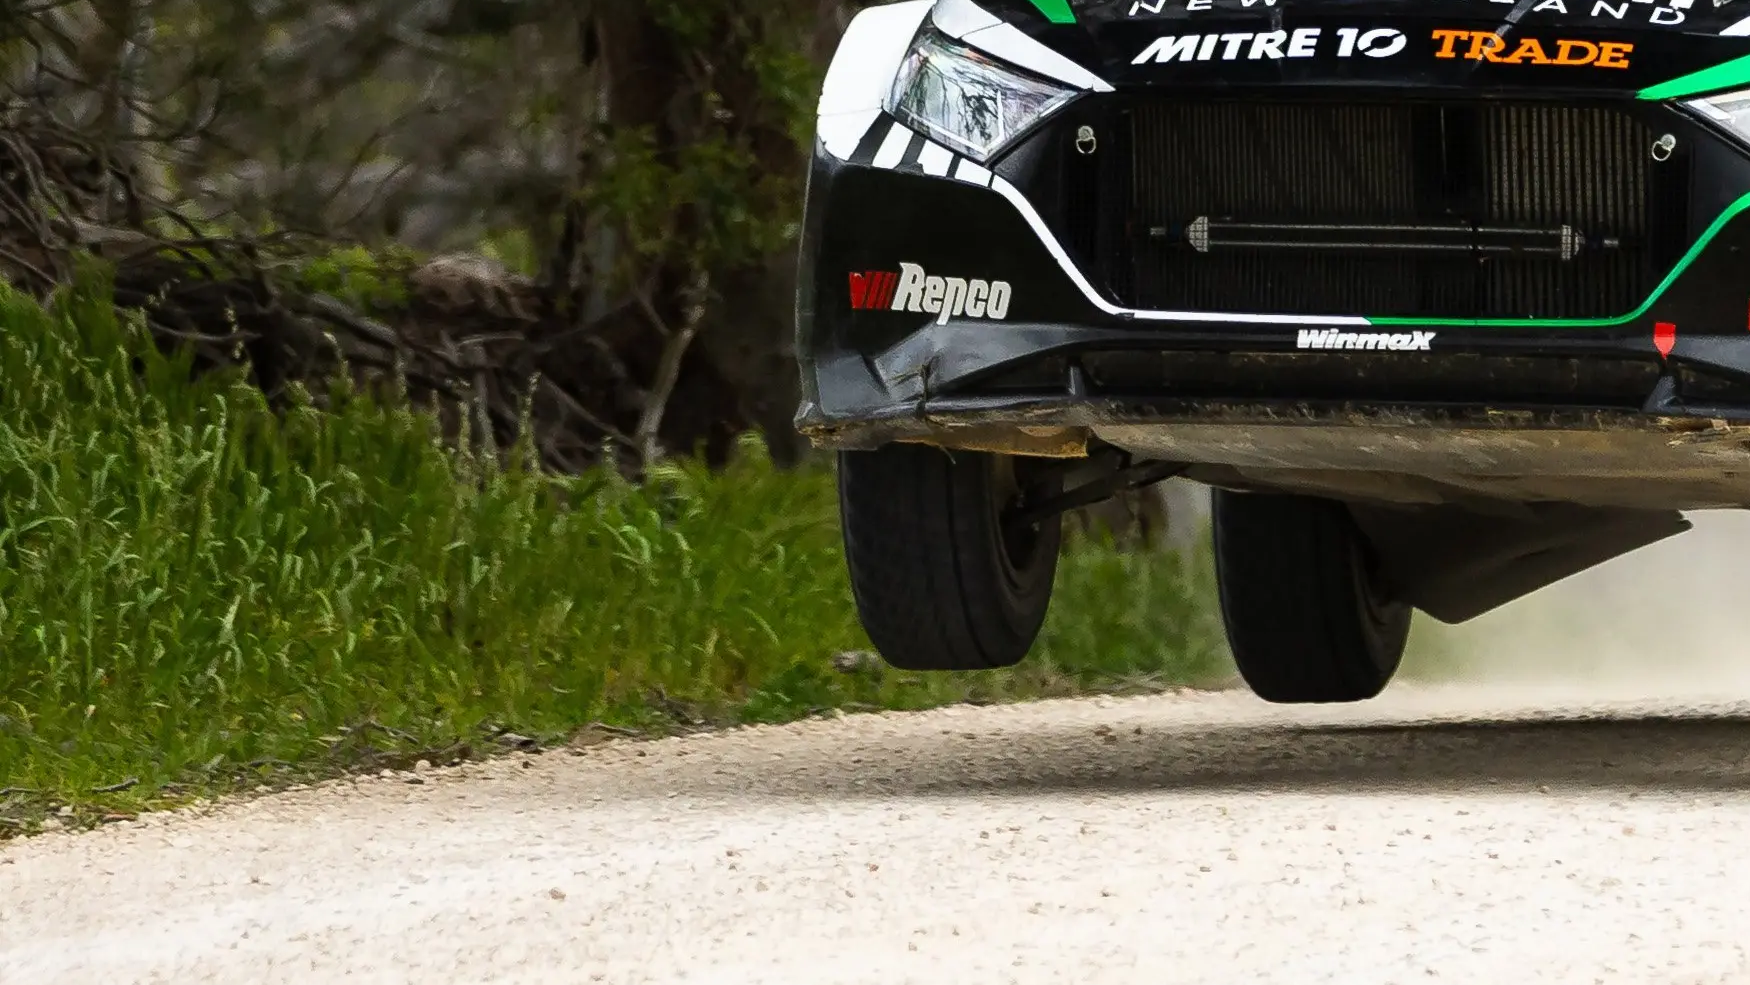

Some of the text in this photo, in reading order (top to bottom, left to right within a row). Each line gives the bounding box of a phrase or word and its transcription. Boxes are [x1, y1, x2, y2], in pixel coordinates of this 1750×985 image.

[1131, 28, 1634, 69] MITRE 10 TRADE
[891, 262, 1012, 326] Repco
